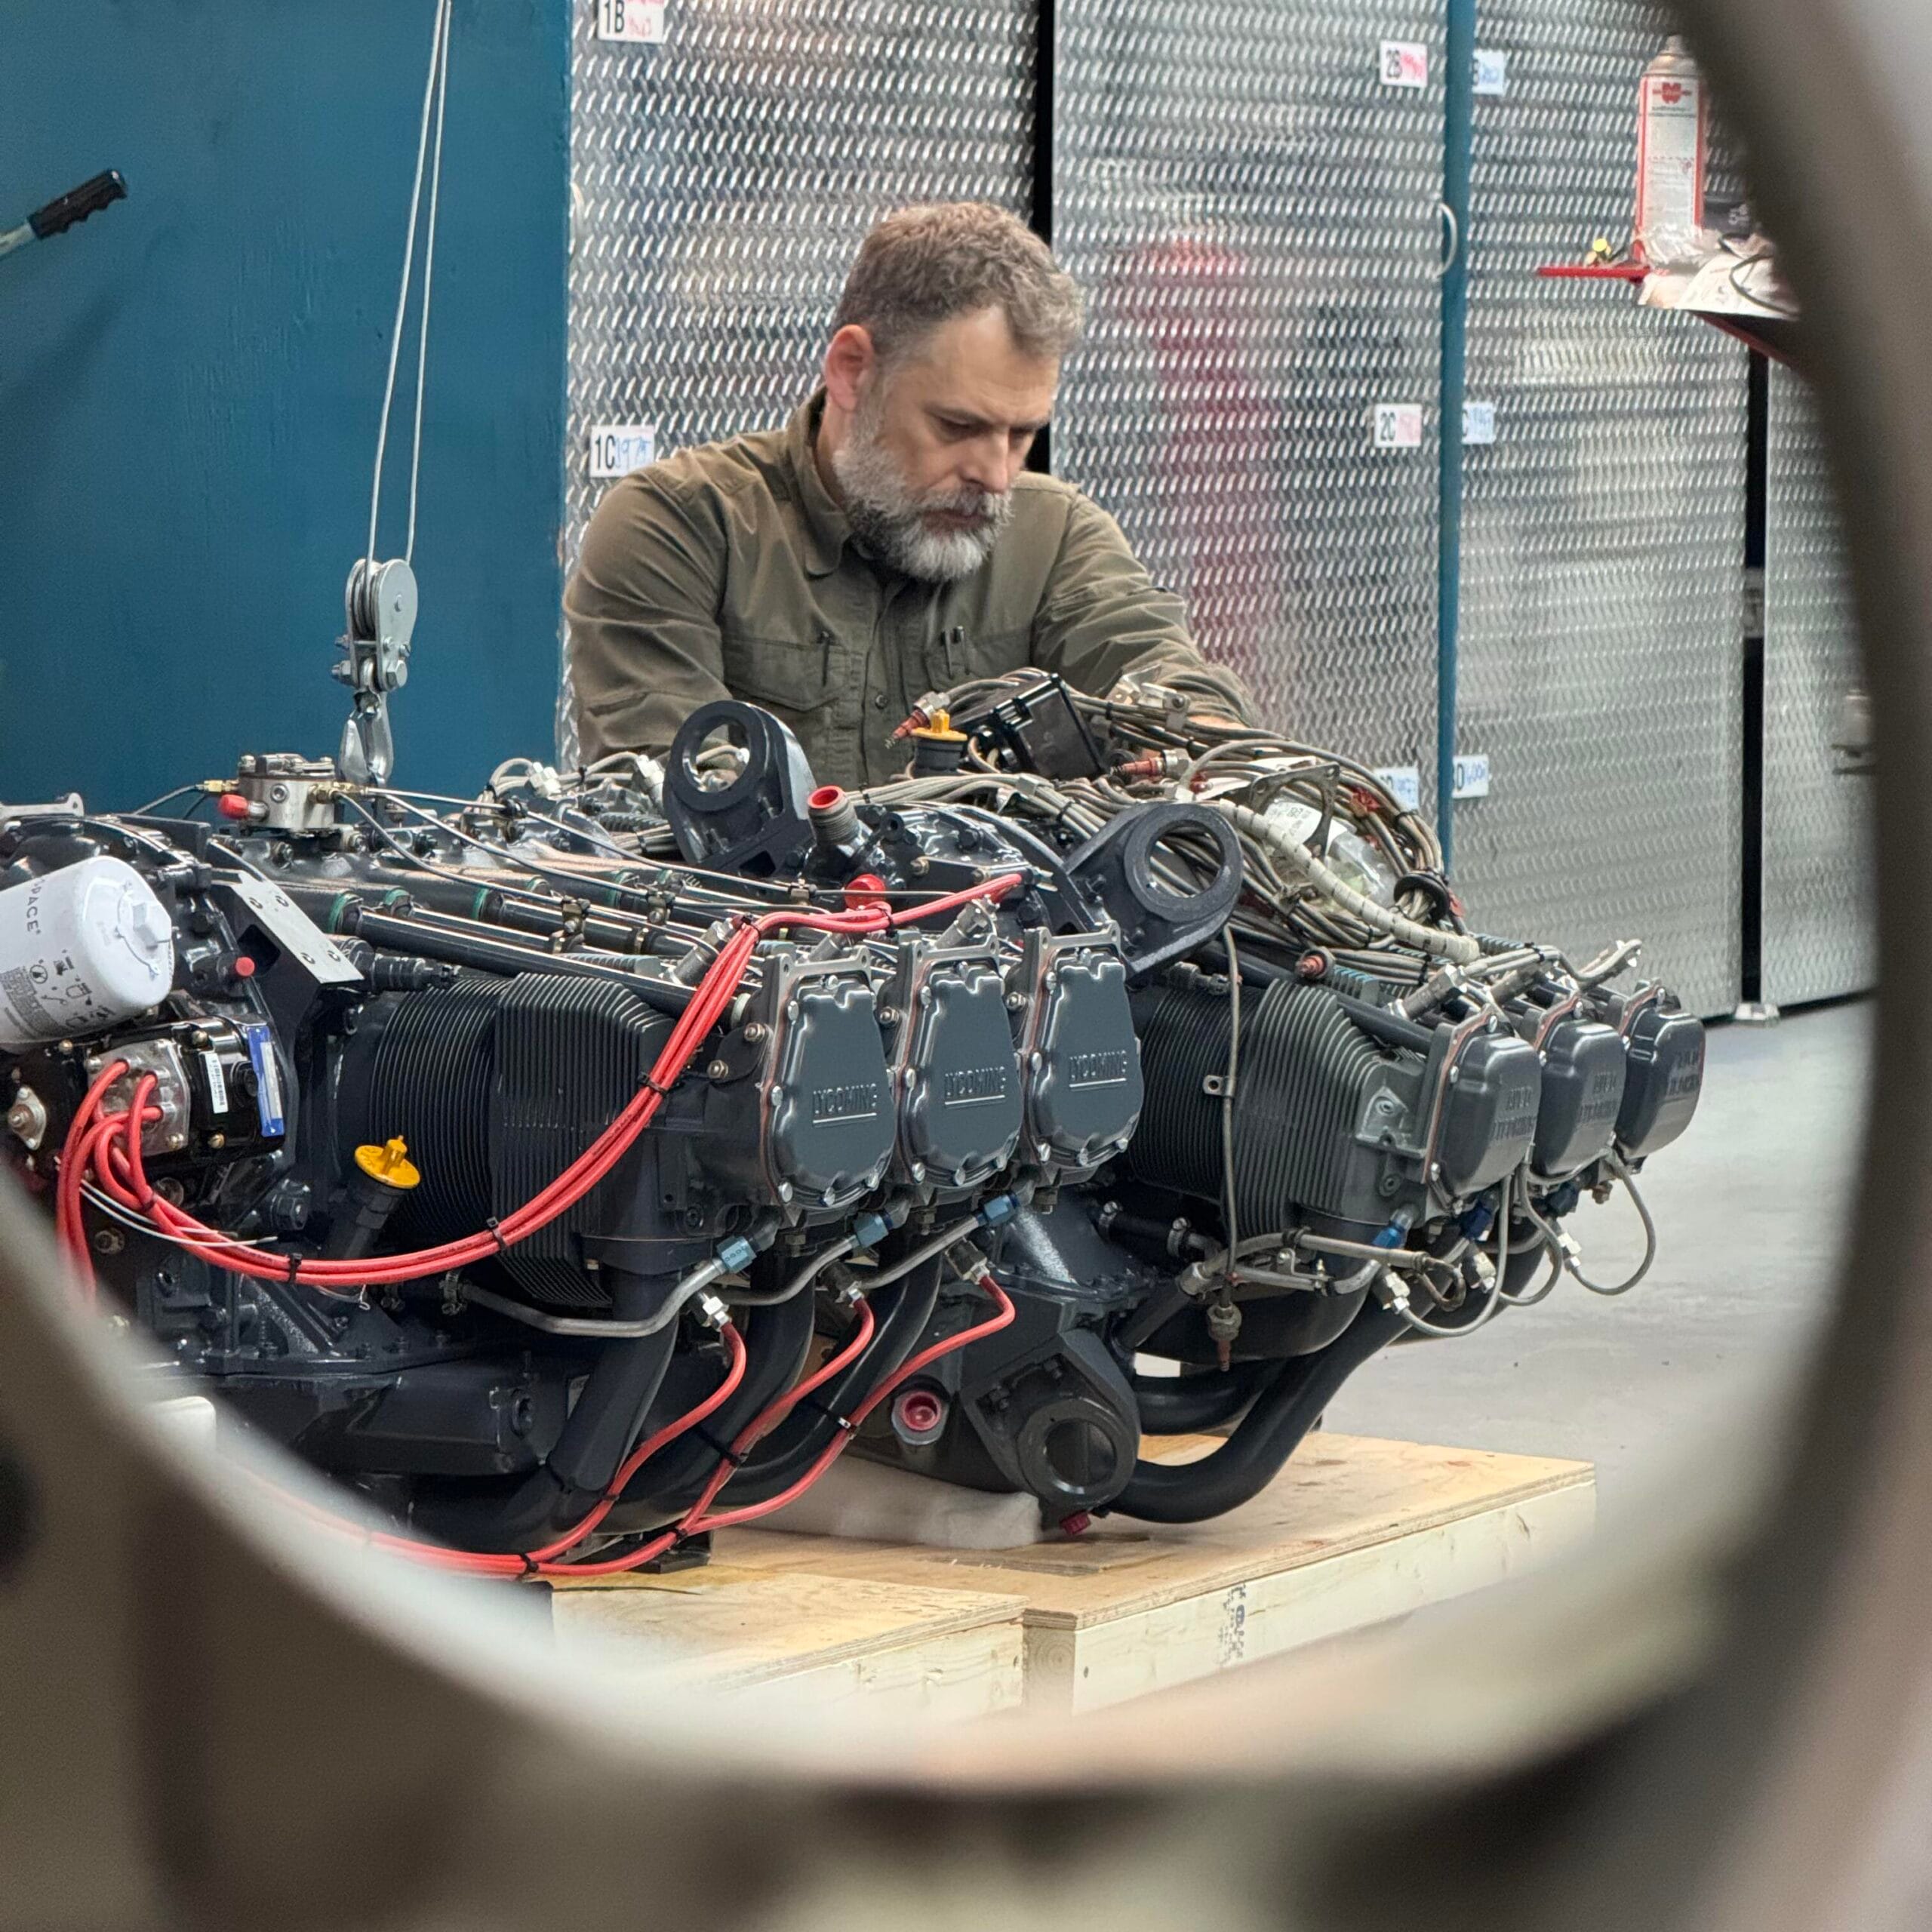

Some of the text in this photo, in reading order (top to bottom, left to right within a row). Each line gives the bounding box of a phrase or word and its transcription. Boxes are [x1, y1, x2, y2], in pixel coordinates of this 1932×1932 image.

[604, 0, 625, 33] 1B
[1380, 412, 1396, 441] 2C
[595, 434, 615, 469] 1C
[812, 1082, 878, 1115] LYCOMING
